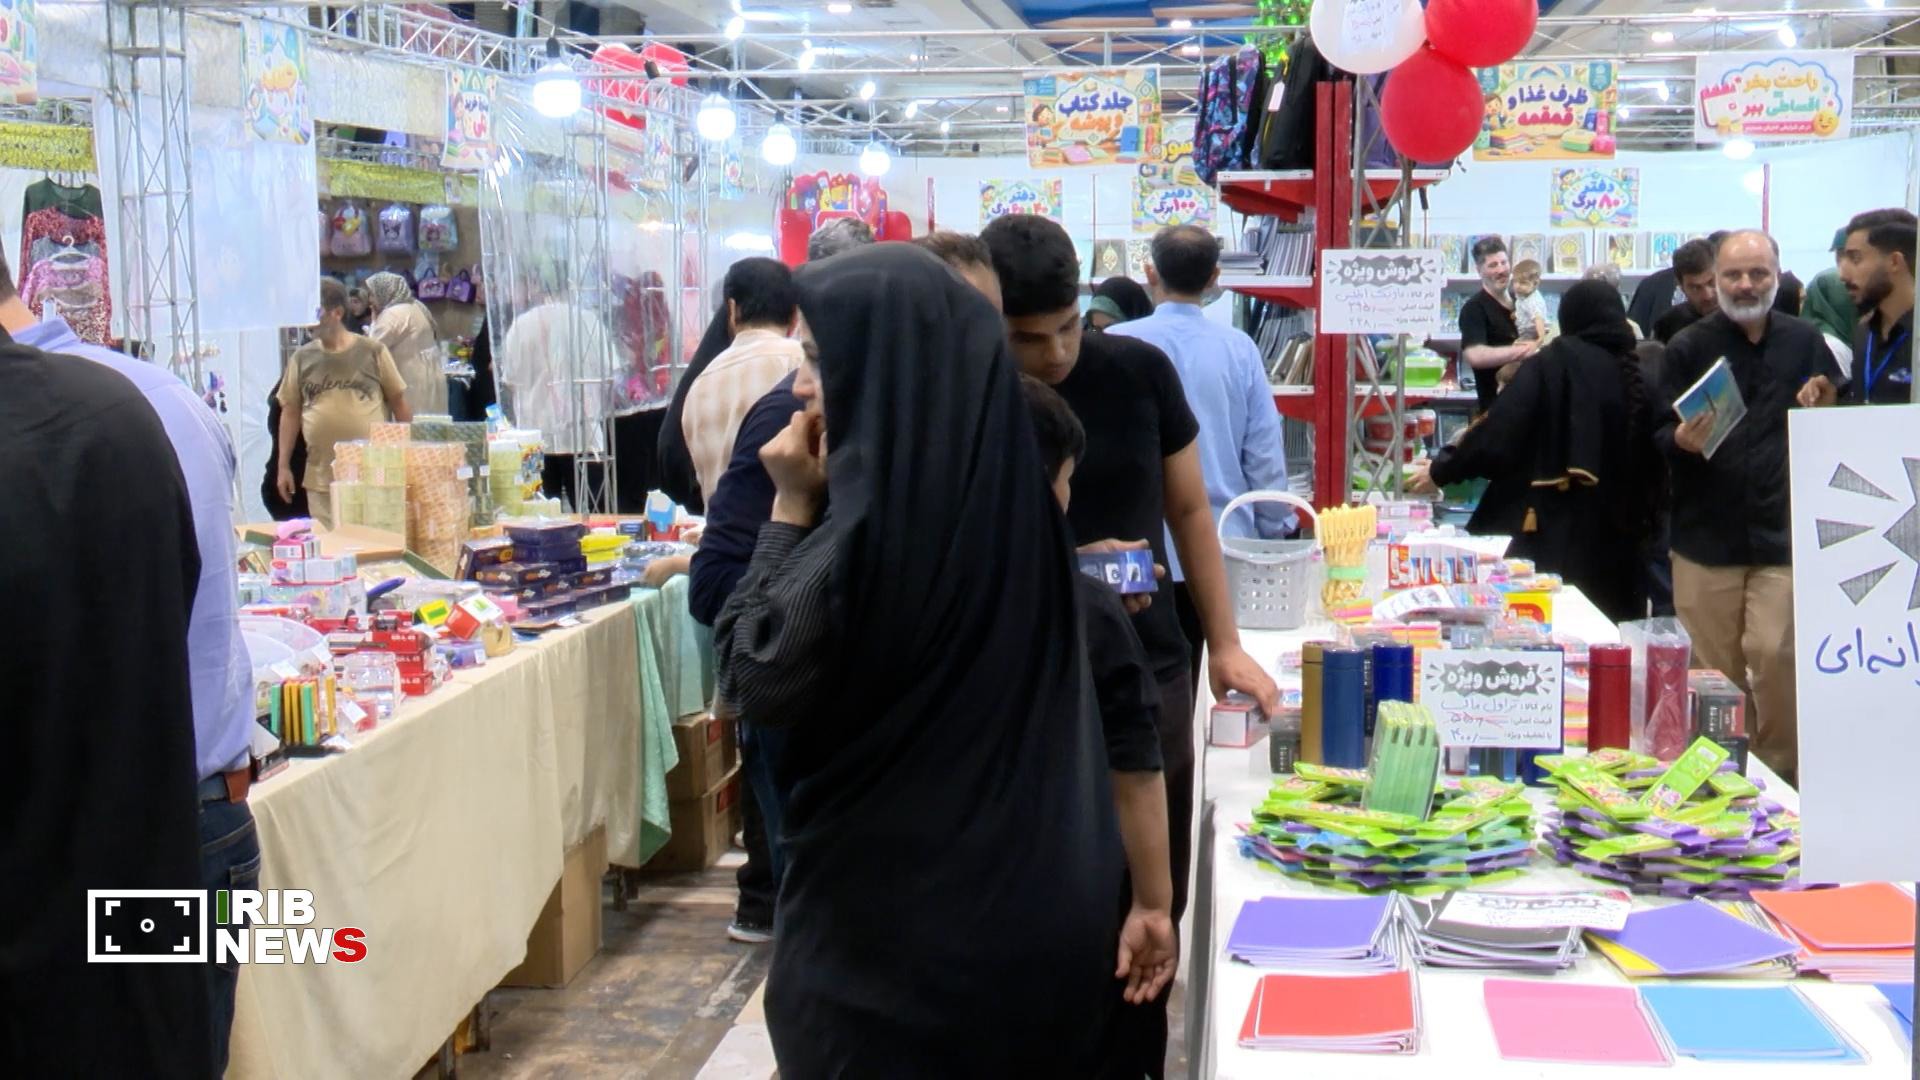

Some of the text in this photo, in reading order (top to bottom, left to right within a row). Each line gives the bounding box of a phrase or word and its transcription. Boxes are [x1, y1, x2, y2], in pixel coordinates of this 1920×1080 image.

[1059, 91, 1134, 117] جلد کتاب
[1508, 84, 1588, 110] ظرف غذا و
[1518, 105, 1574, 126] قمقمه
[1582, 179, 1615, 193] دفتر
[1009, 189, 1036, 204] دفتر
[1153, 197, 1196, 214] ۱۰۰ برگ
[1572, 191, 1620, 209] ۸۰ برگ
[1343, 260, 1420, 281] فروش ویژه
[1447, 666, 1537, 690] فروش ویژه
[1540, 703, 1553, 712] نام
[1533, 717, 1553, 727] قیمت
